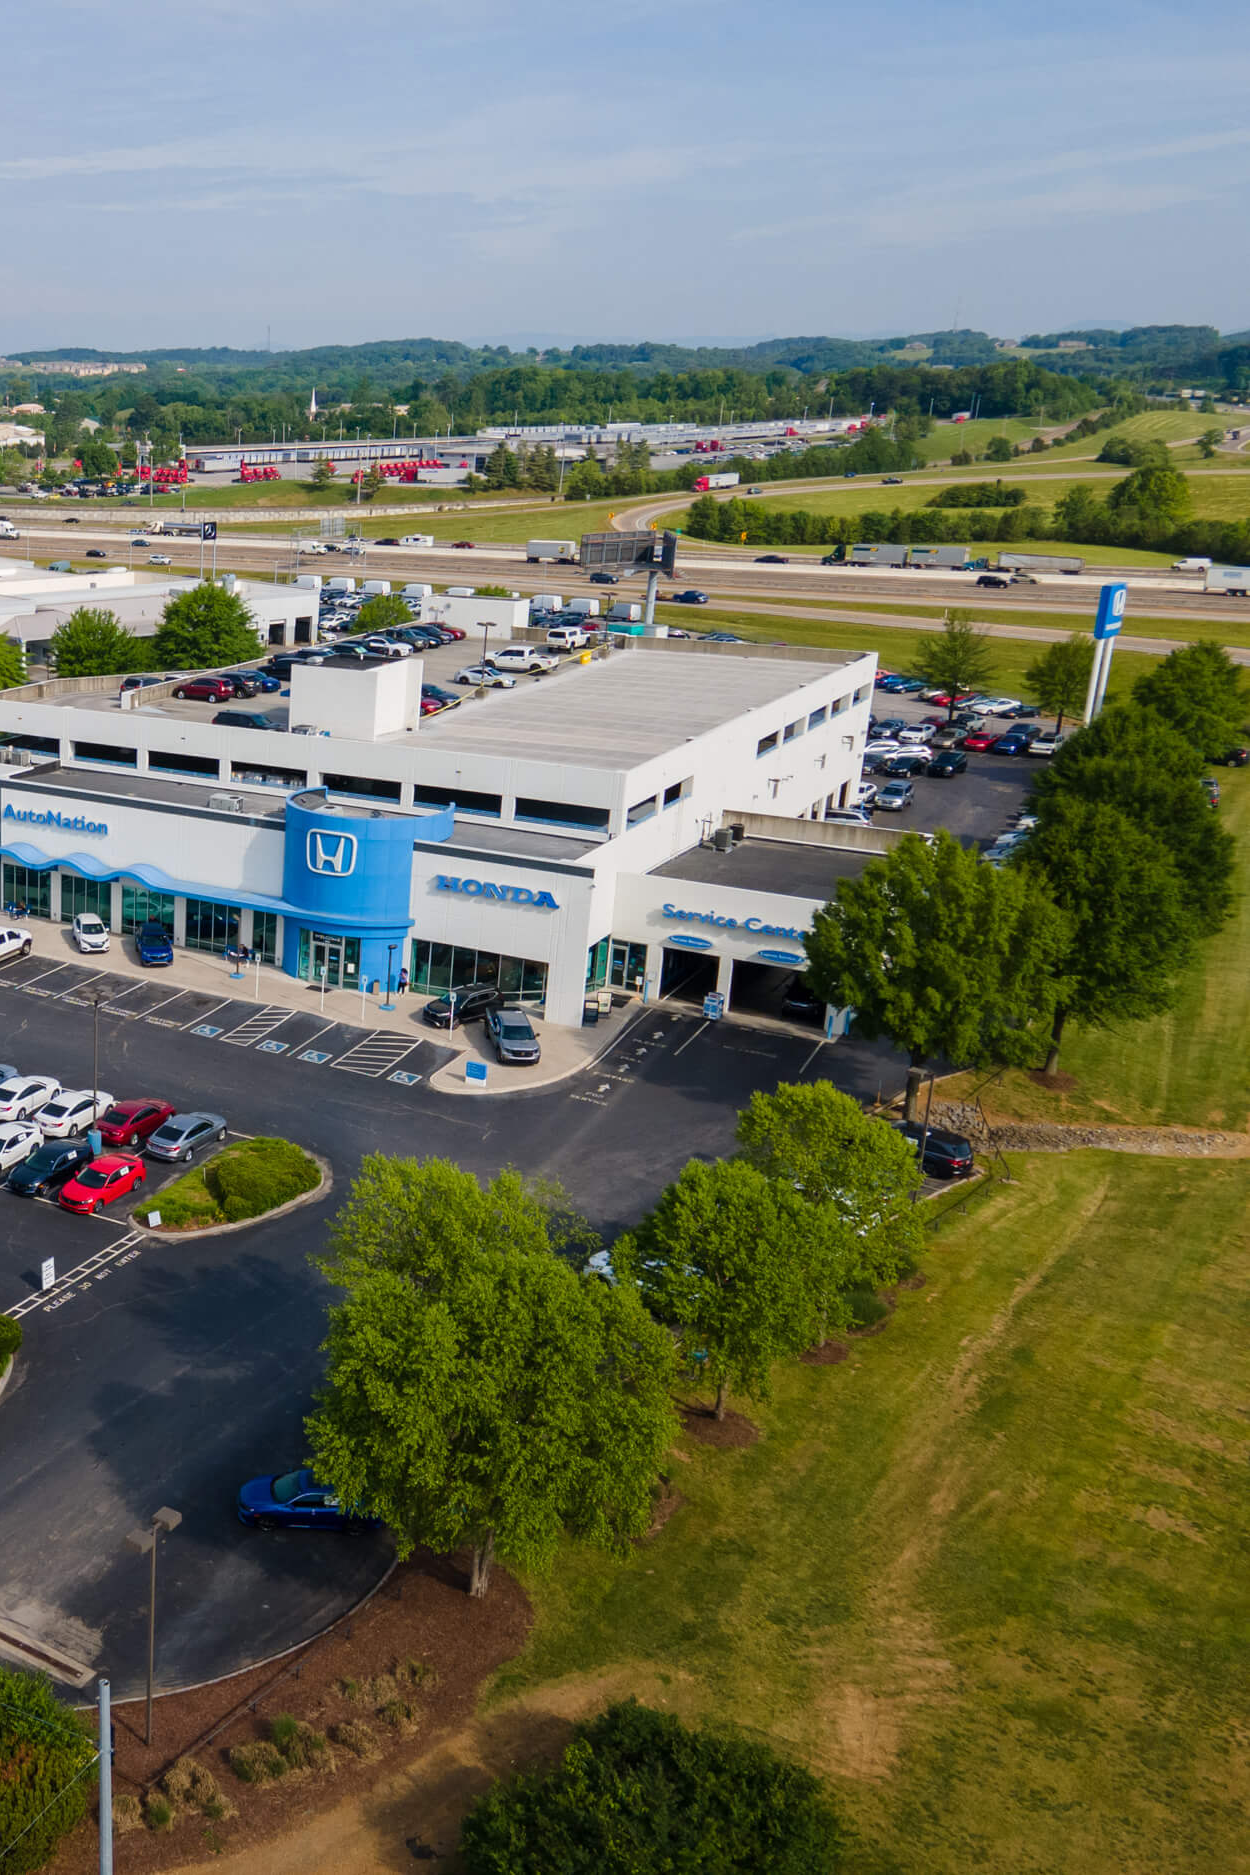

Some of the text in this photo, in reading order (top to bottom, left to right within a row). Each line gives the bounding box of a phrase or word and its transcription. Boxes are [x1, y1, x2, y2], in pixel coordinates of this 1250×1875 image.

[3, 803, 109, 836] AutoNation
[436, 875, 560, 910] HONDA
[662, 903, 738, 930] Service
[744, 917, 806, 942] Cente
[43, 1291, 77, 1312] PLEASE
[94, 1268, 113, 1280] NOT
[114, 1249, 143, 1267] ENTER
